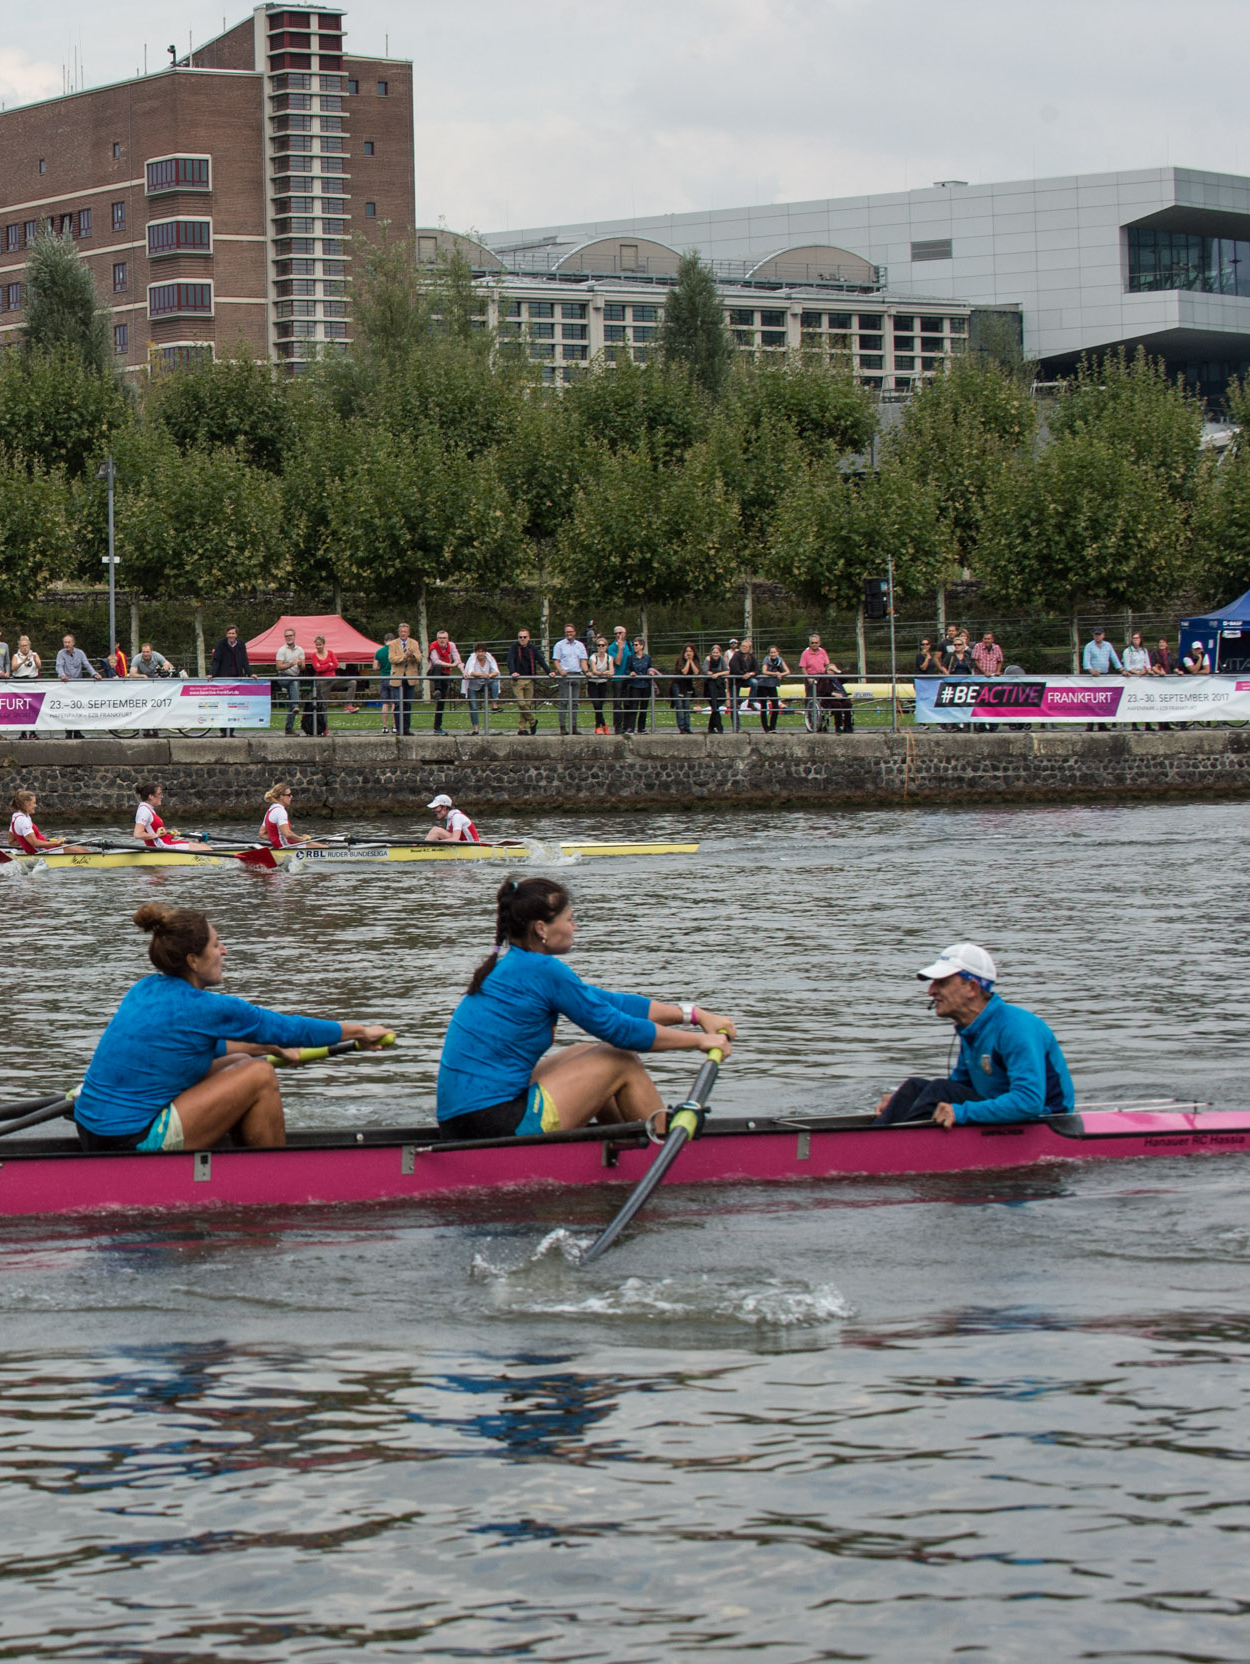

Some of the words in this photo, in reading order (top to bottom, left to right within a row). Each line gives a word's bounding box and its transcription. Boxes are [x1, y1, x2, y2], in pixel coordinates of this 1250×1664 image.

[941, 686, 1042, 703] #BEACTIVE
[1047, 692, 1113, 704] FRANKFURT
[1158, 693, 1208, 703] SEPTEMBER
[1211, 693, 1230, 701] 2017
[87, 699, 148, 709] SEPTEMBER
[150, 698, 173, 708] 2017
[306, 850, 326, 858] RBL
[1144, 1137, 1190, 1147] Hanauer
[1211, 1134, 1246, 1144] Hassia
